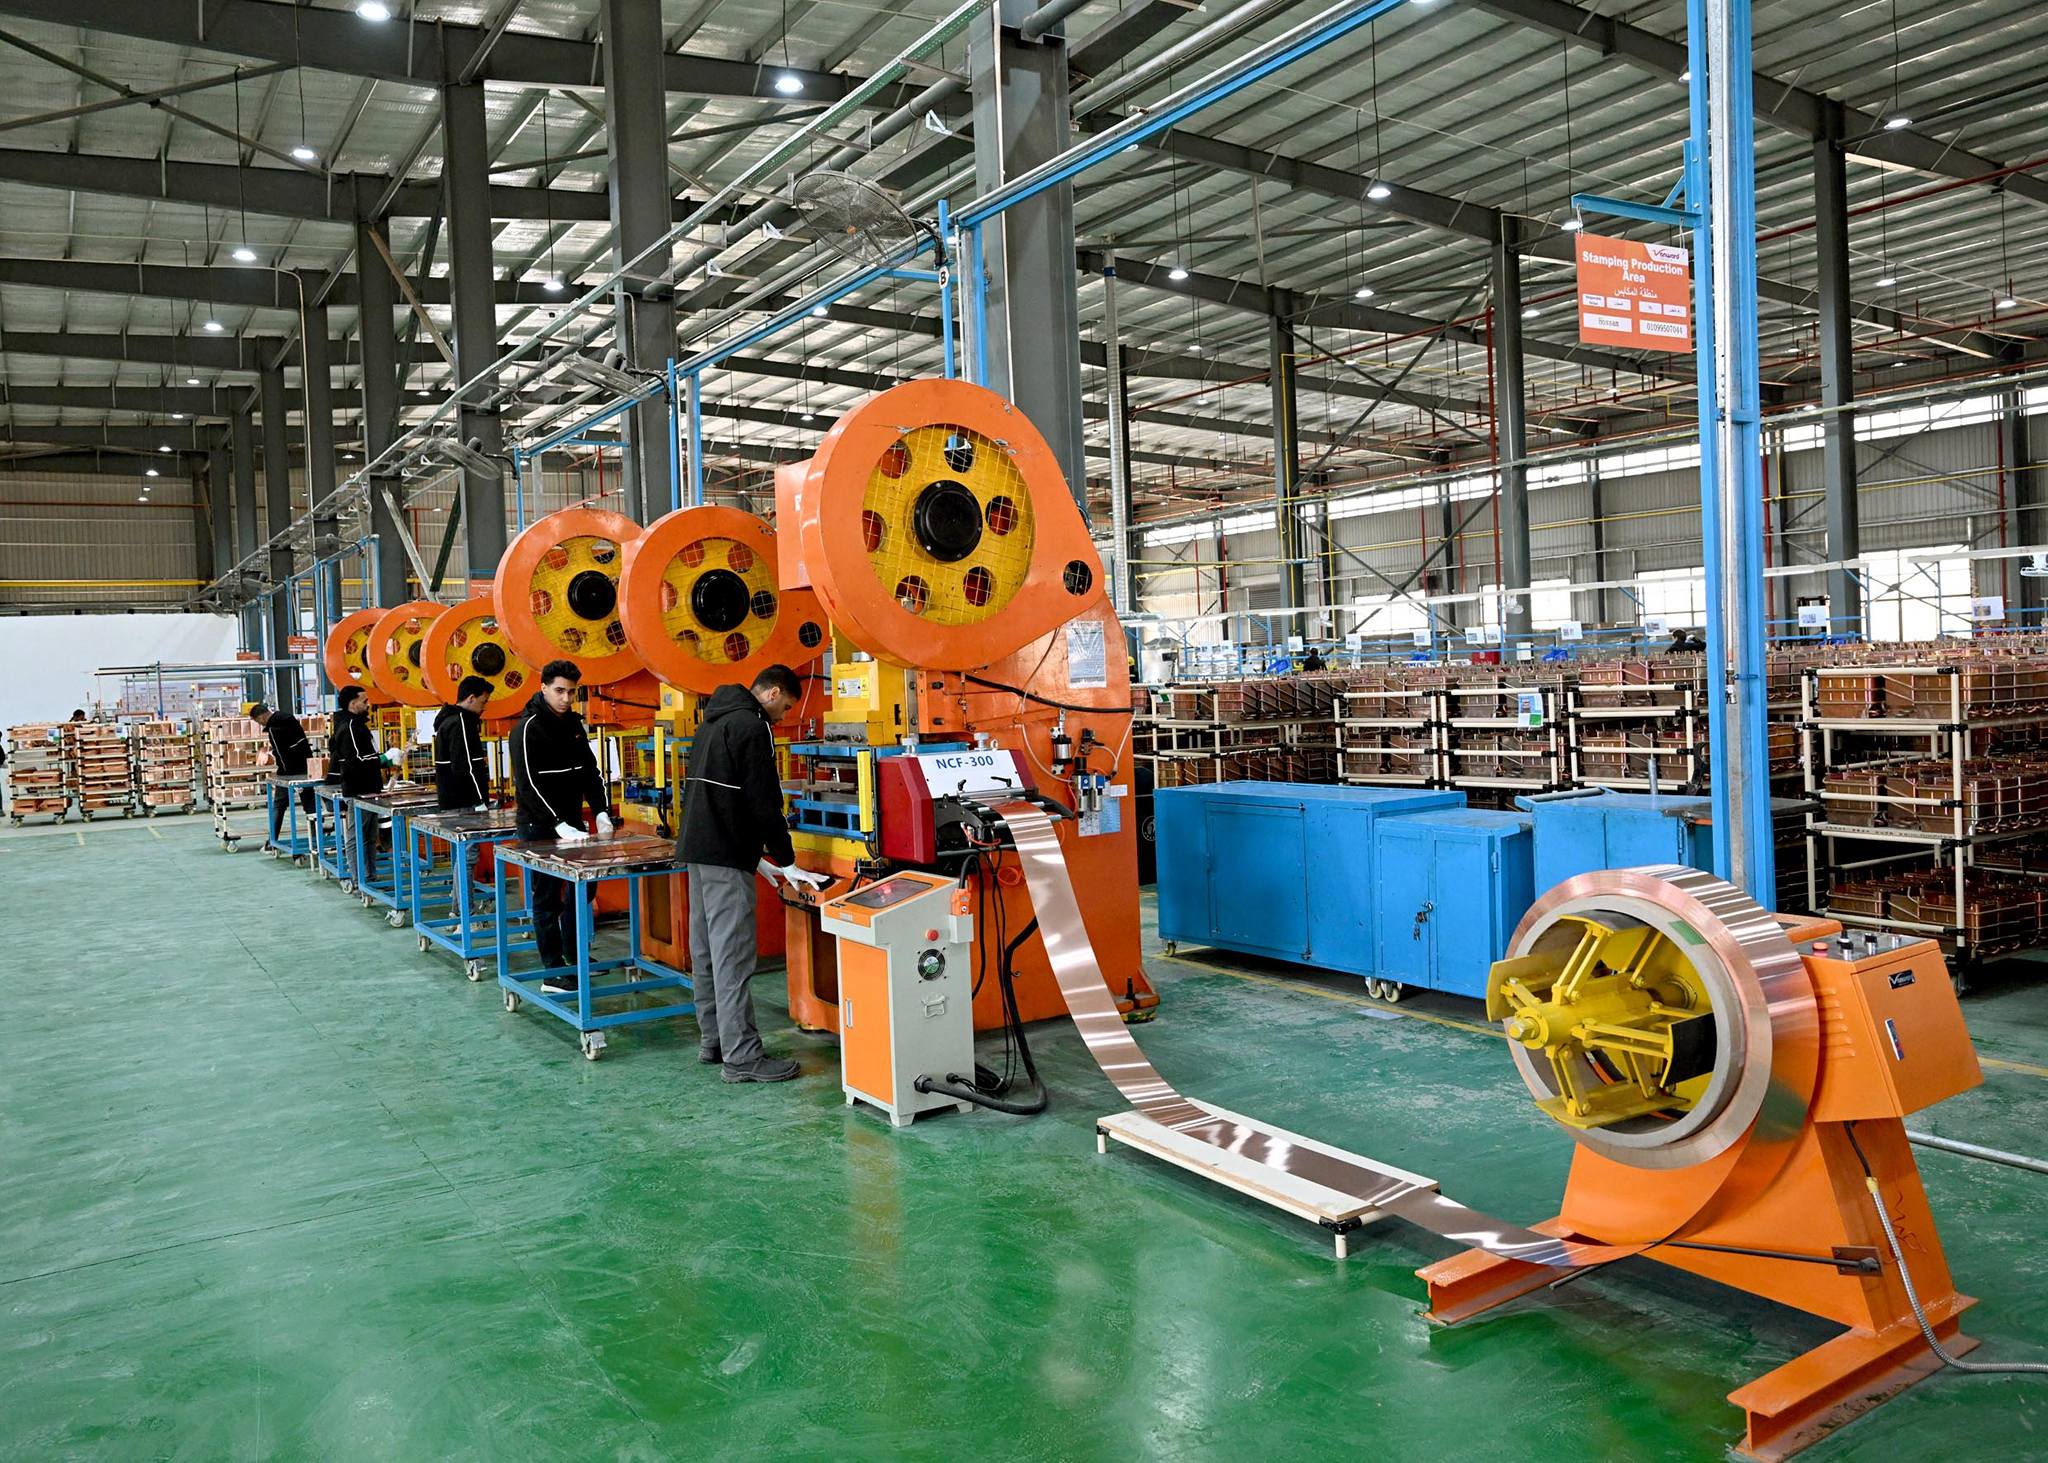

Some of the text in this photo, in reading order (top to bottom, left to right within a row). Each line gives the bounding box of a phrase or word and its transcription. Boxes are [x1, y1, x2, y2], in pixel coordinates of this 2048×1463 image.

[1582, 251, 1683, 275] Stamping Production
[1622, 271, 1645, 283] Area
[936, 755, 994, 769] NCF-300
